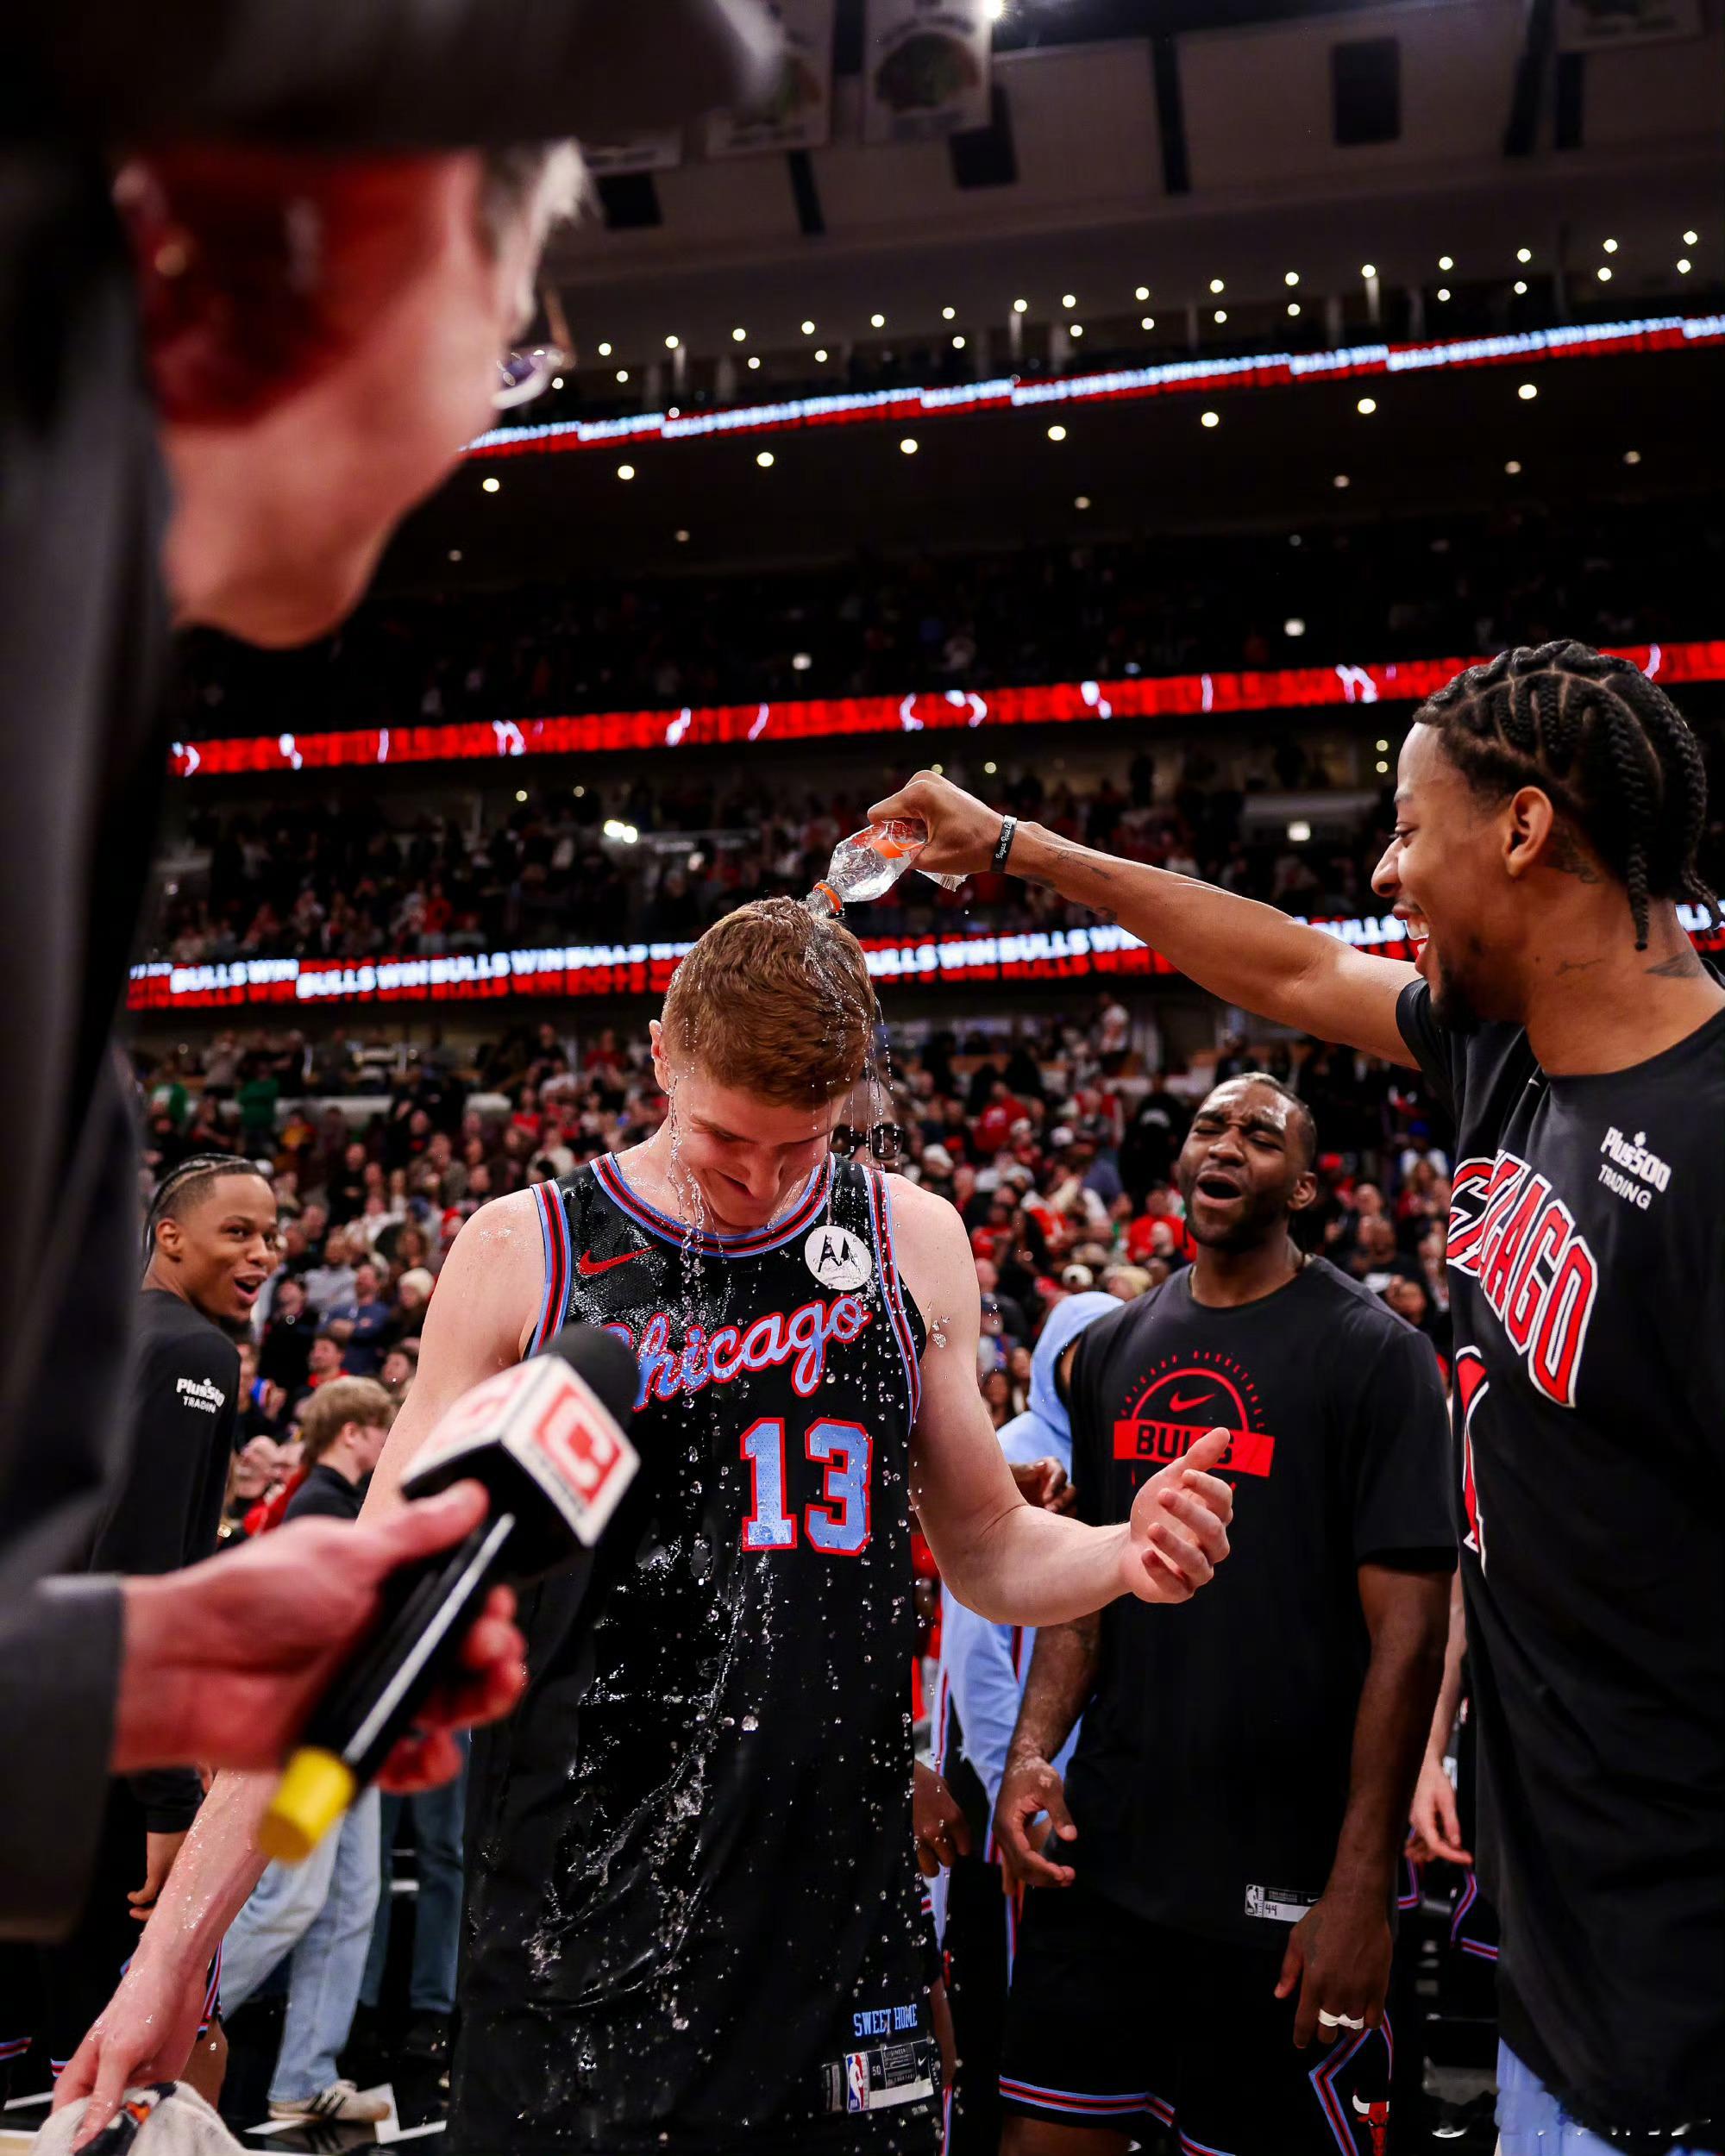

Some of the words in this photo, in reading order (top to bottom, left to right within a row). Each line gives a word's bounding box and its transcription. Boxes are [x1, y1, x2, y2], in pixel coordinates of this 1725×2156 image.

[998, 928, 1089, 962] BULLS
[171, 962, 248, 994] BULLS
[297, 965, 376, 1000] BULLS
[430, 951, 511, 984] BULLS
[1600, 1126, 1672, 1193] Plus500
[1598, 1163, 1653, 1211] TRADING
[183, 1395, 216, 1413] TRADIN
[1136, 1424, 1235, 1465] BULS
[740, 1417, 873, 1557] 13
[853, 2009, 892, 2037] SWEET
[893, 2003, 918, 2030] HOME
